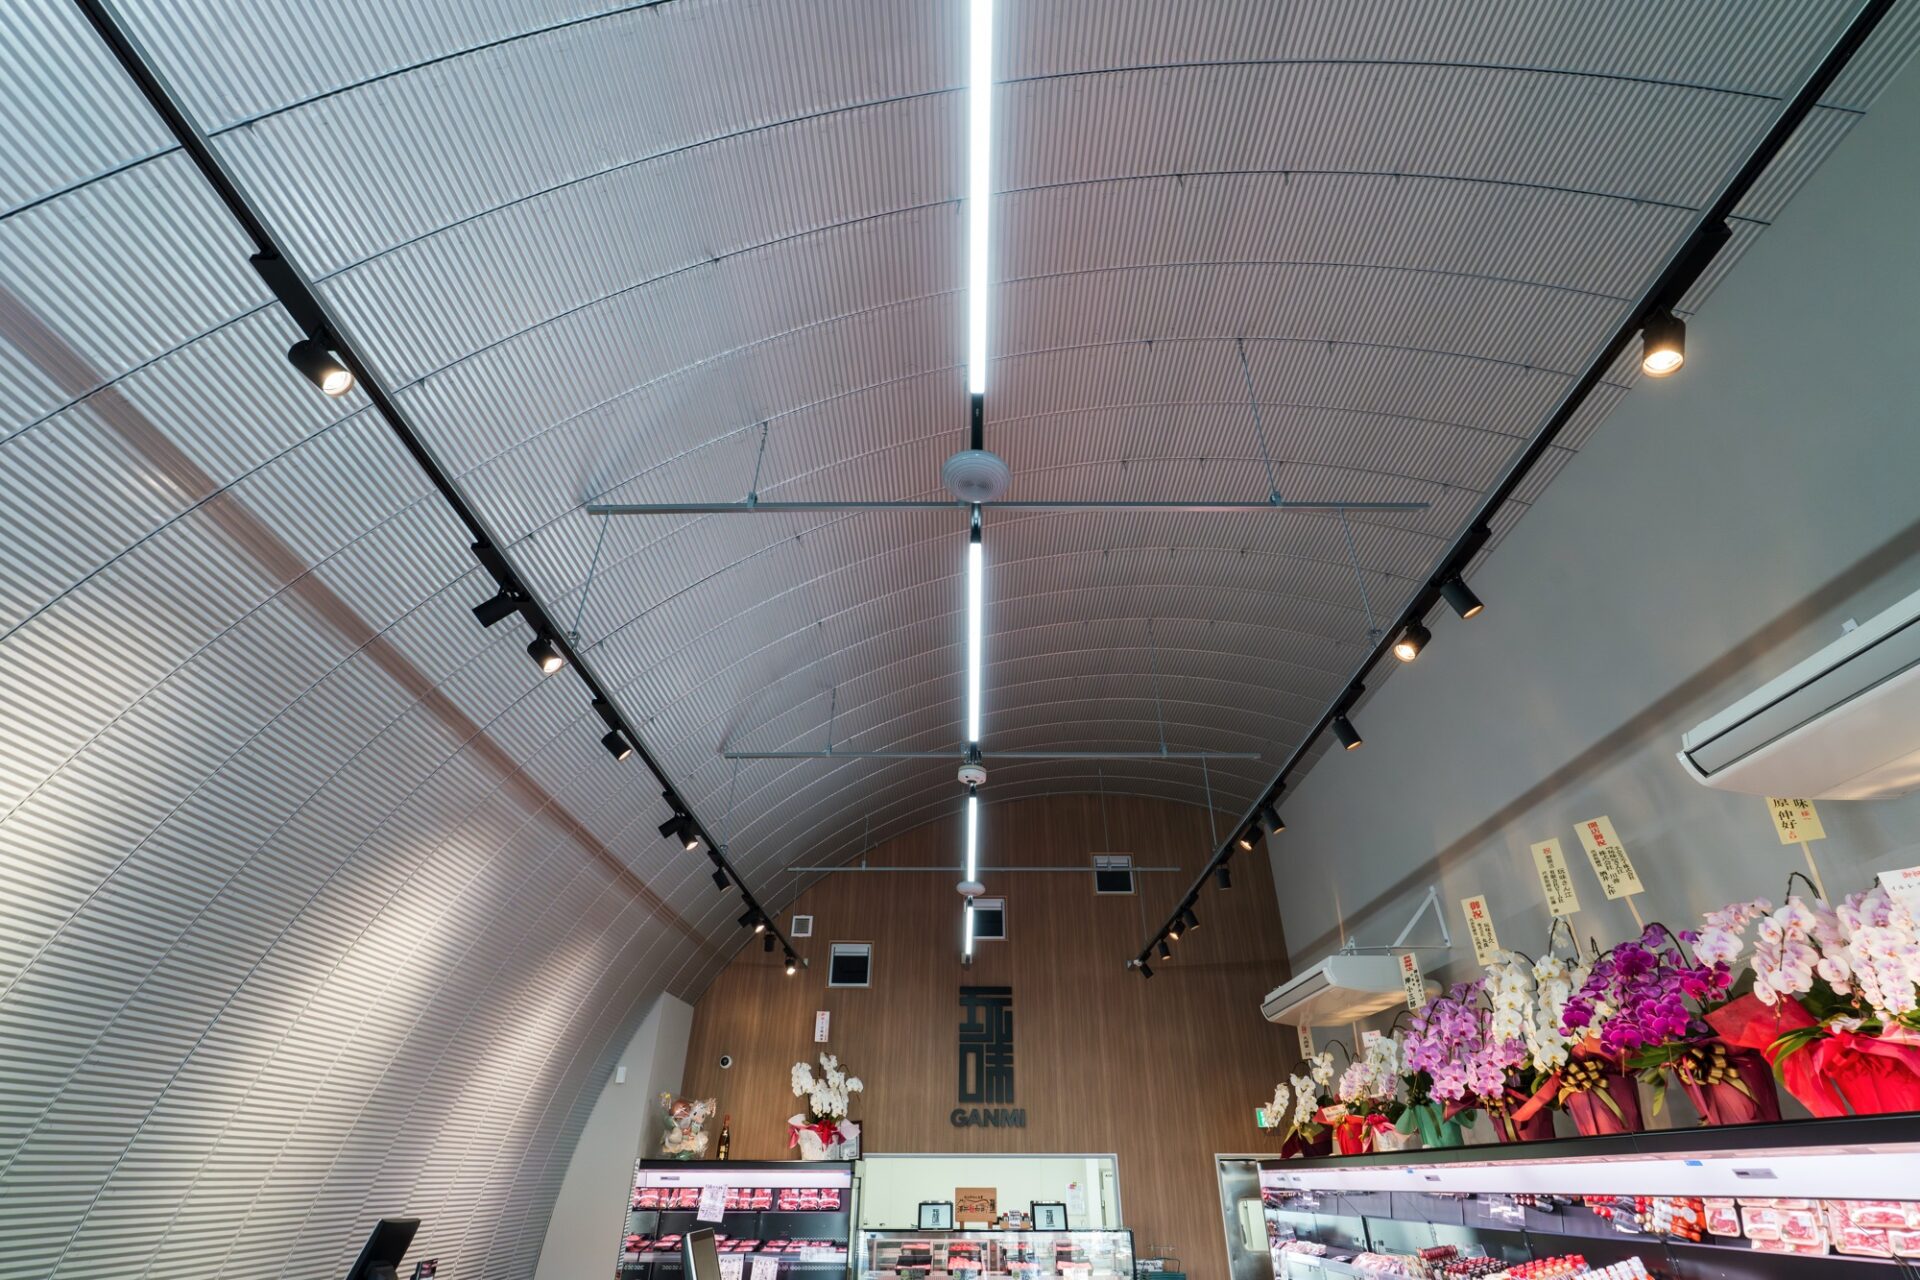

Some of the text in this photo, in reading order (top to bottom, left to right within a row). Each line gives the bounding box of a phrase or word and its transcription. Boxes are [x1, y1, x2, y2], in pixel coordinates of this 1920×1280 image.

[1587, 821, 1607, 848] 開店御祝
[950, 1108, 1026, 1128] GANMI
